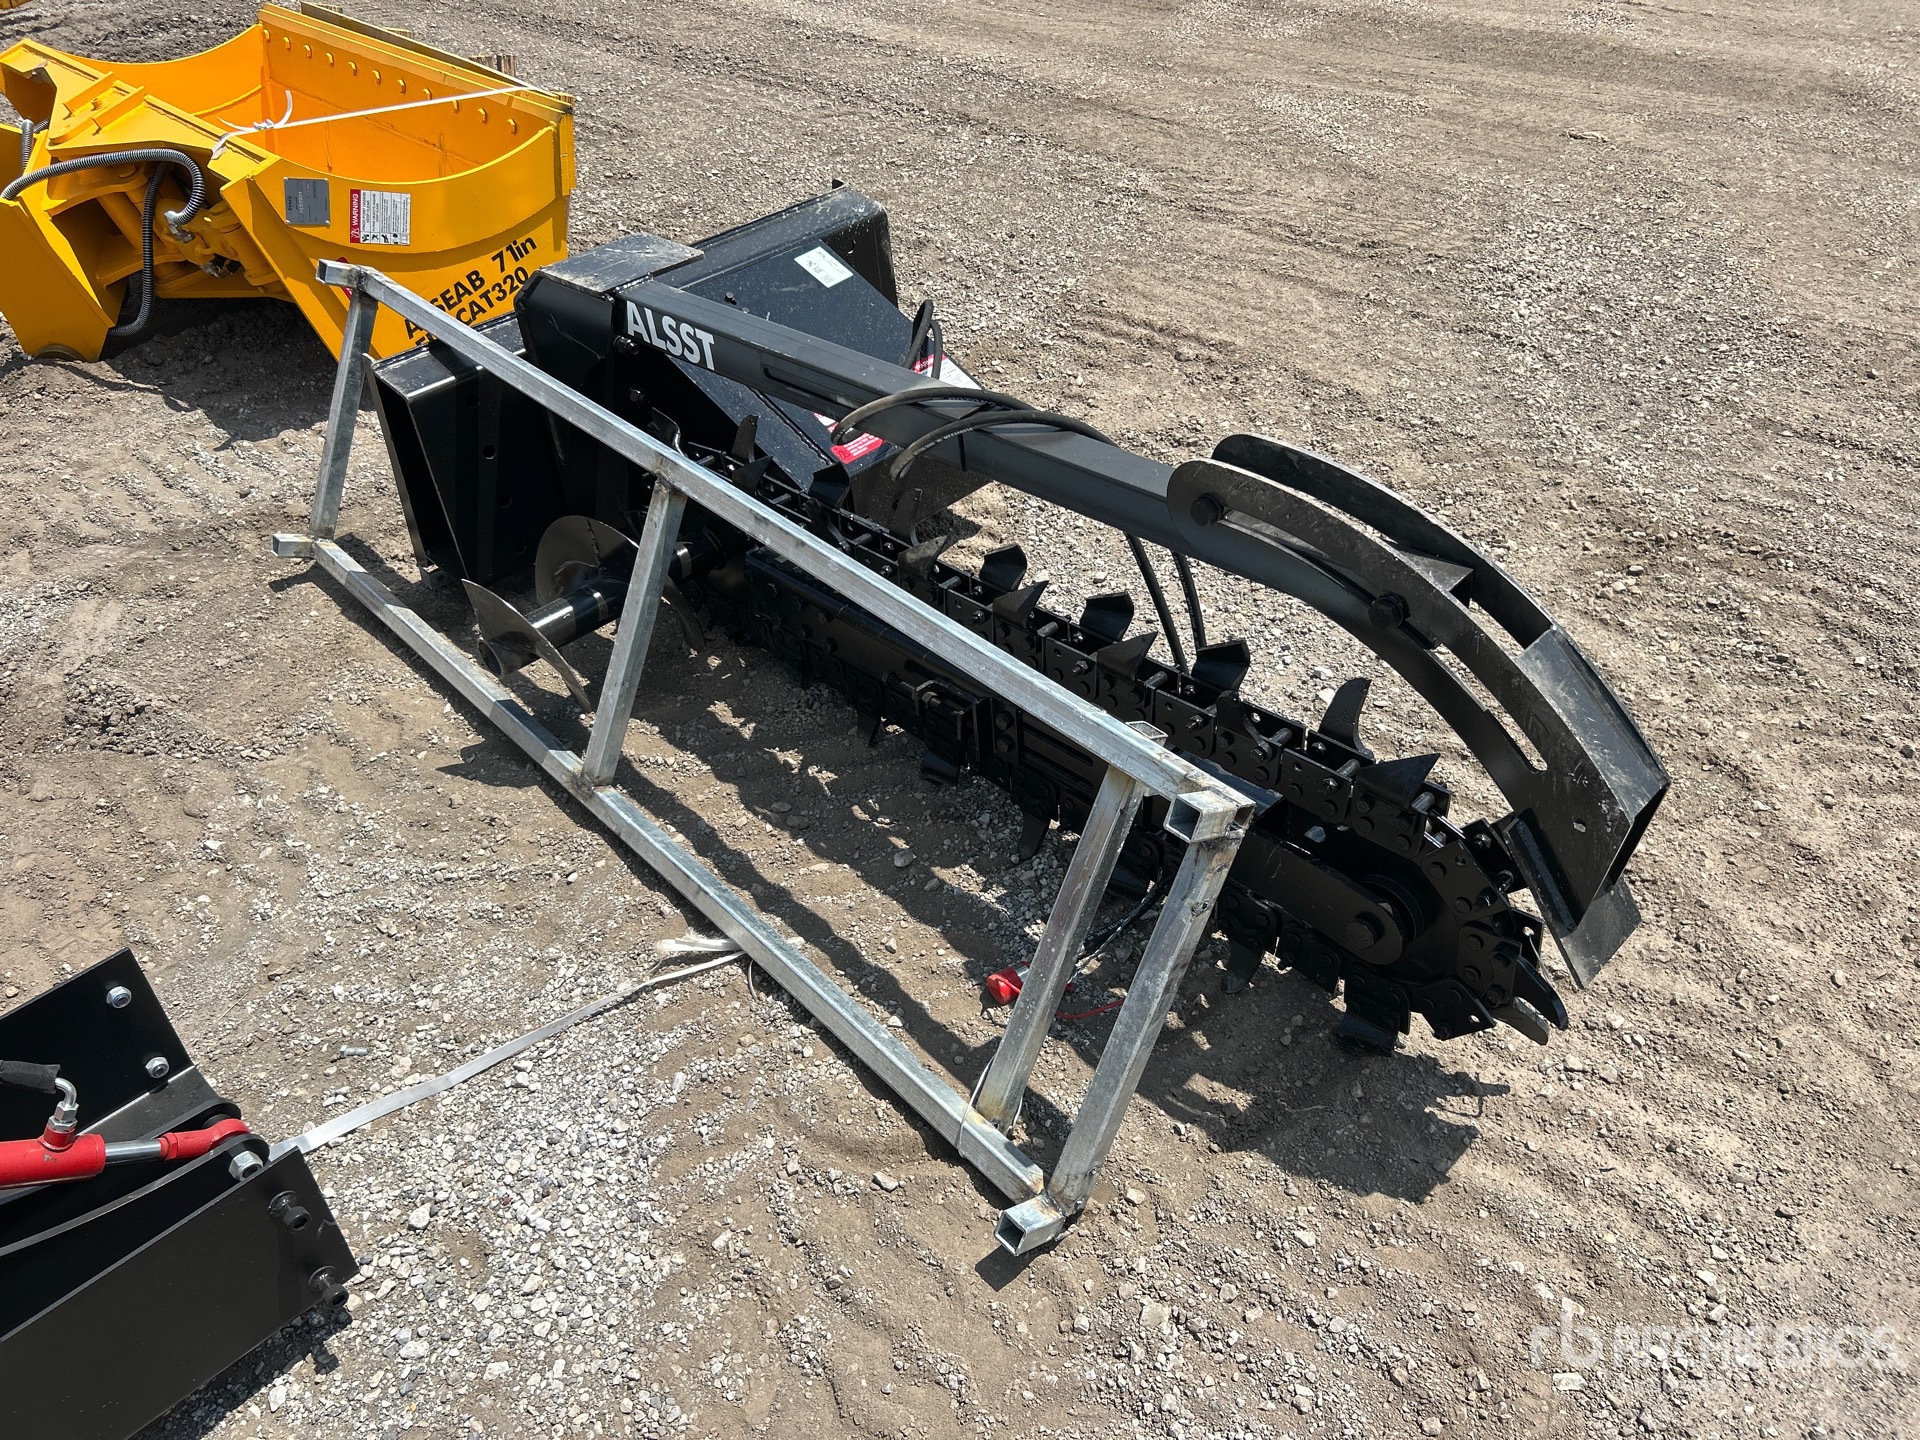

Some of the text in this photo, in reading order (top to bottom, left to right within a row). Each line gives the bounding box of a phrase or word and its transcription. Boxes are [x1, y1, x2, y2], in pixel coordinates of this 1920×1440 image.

[404, 237, 537, 339] ASEAB 71in
[455, 266, 529, 327] CAT320
[626, 300, 715, 371] ALSST
